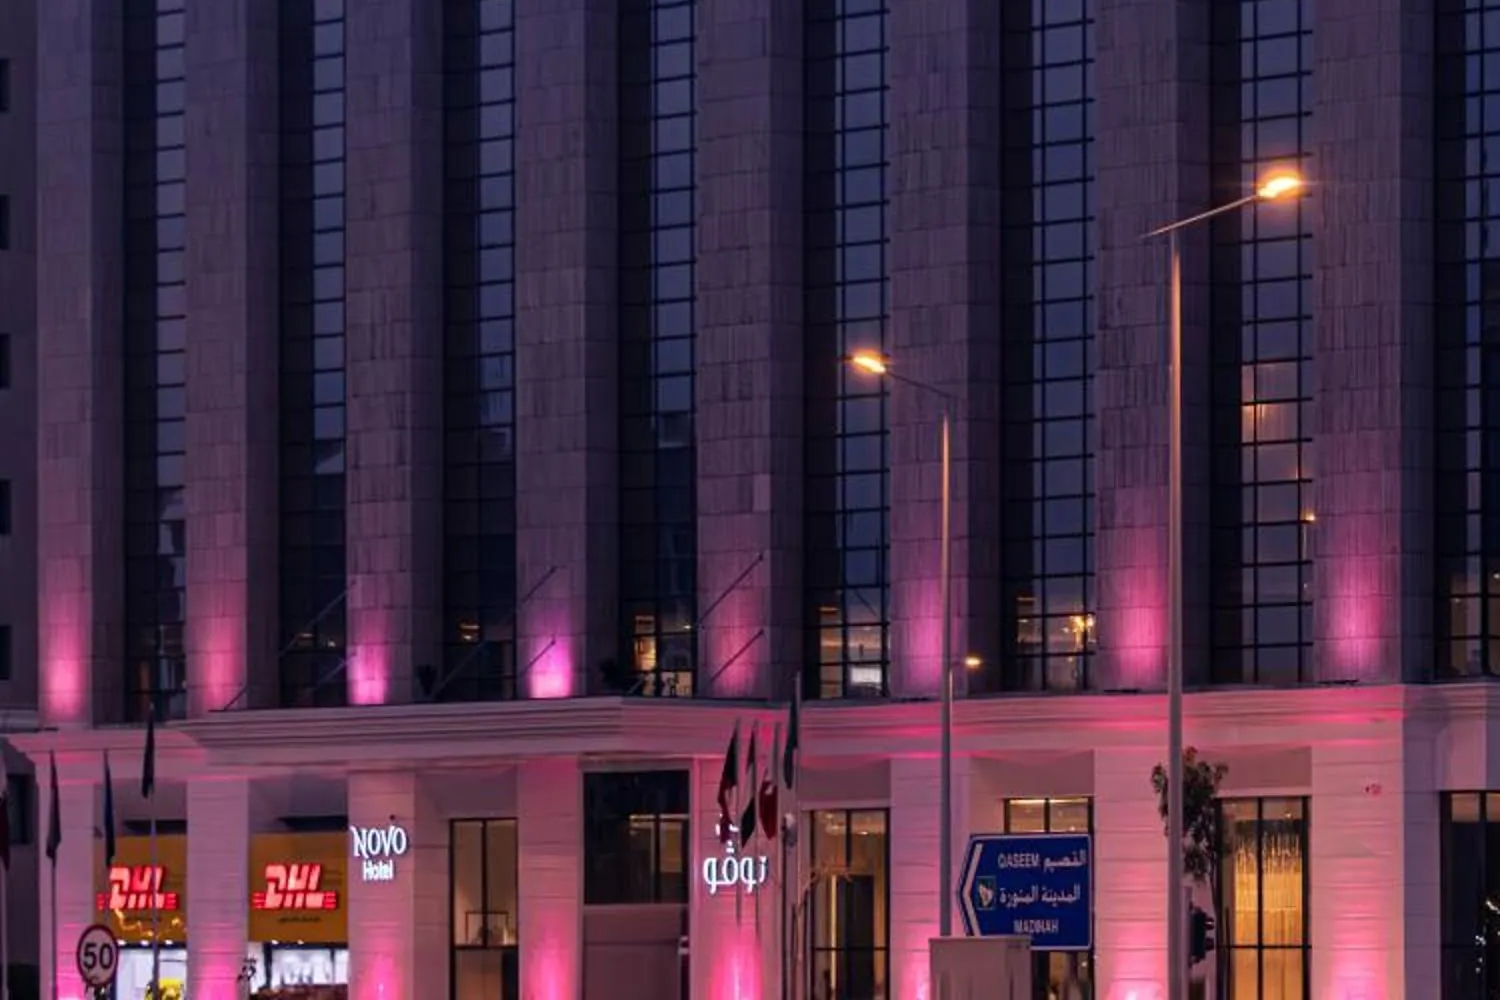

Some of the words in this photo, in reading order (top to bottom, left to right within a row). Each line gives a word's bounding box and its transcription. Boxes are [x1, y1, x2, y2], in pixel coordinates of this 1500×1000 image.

[349, 825, 407, 859] NOVO
[363, 859, 394, 881] Hotel
[1042, 848, 1087, 873] القصيم
[109, 865, 165, 909] DHL
[264, 863, 325, 909] DHL
[1041, 883, 1081, 907] المدينة
[83, 942, 114, 970] 50
